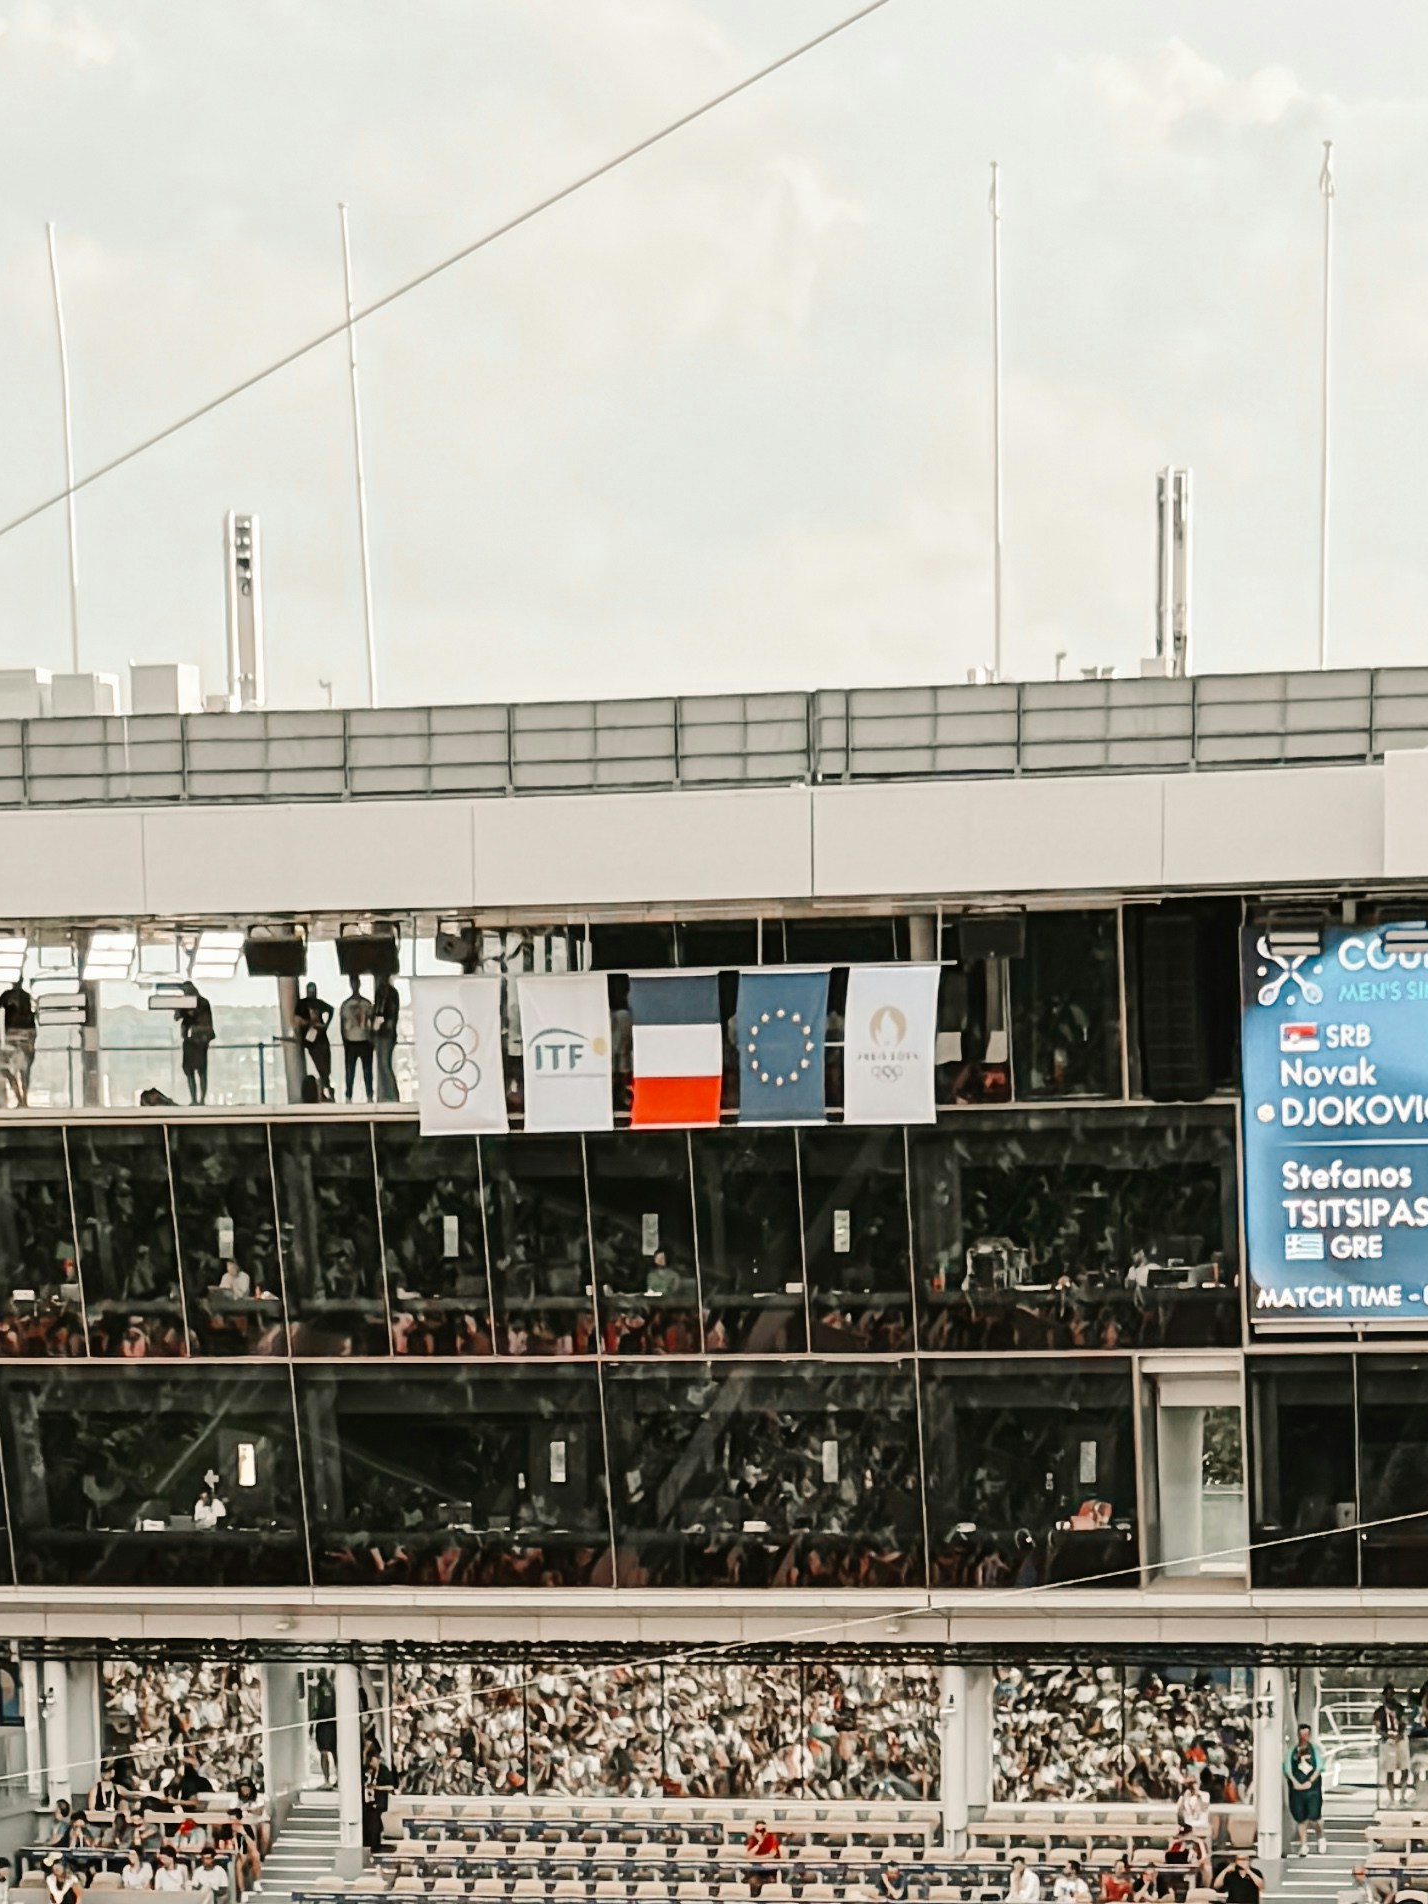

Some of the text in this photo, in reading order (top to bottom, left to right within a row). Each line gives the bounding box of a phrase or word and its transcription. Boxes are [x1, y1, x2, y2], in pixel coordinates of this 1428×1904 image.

[1338, 980, 1402, 1002] MEN'S
[1324, 1025, 1371, 1048] SRB
[535, 1043, 585, 1070] ITF
[1280, 1058, 1376, 1088] Novak
[1282, 1159, 1412, 1191] Stefanos
[1330, 1236, 1383, 1260] GRE
[1256, 1286, 1342, 1310] MATCH
[1349, 1285, 1402, 1309] TIME
